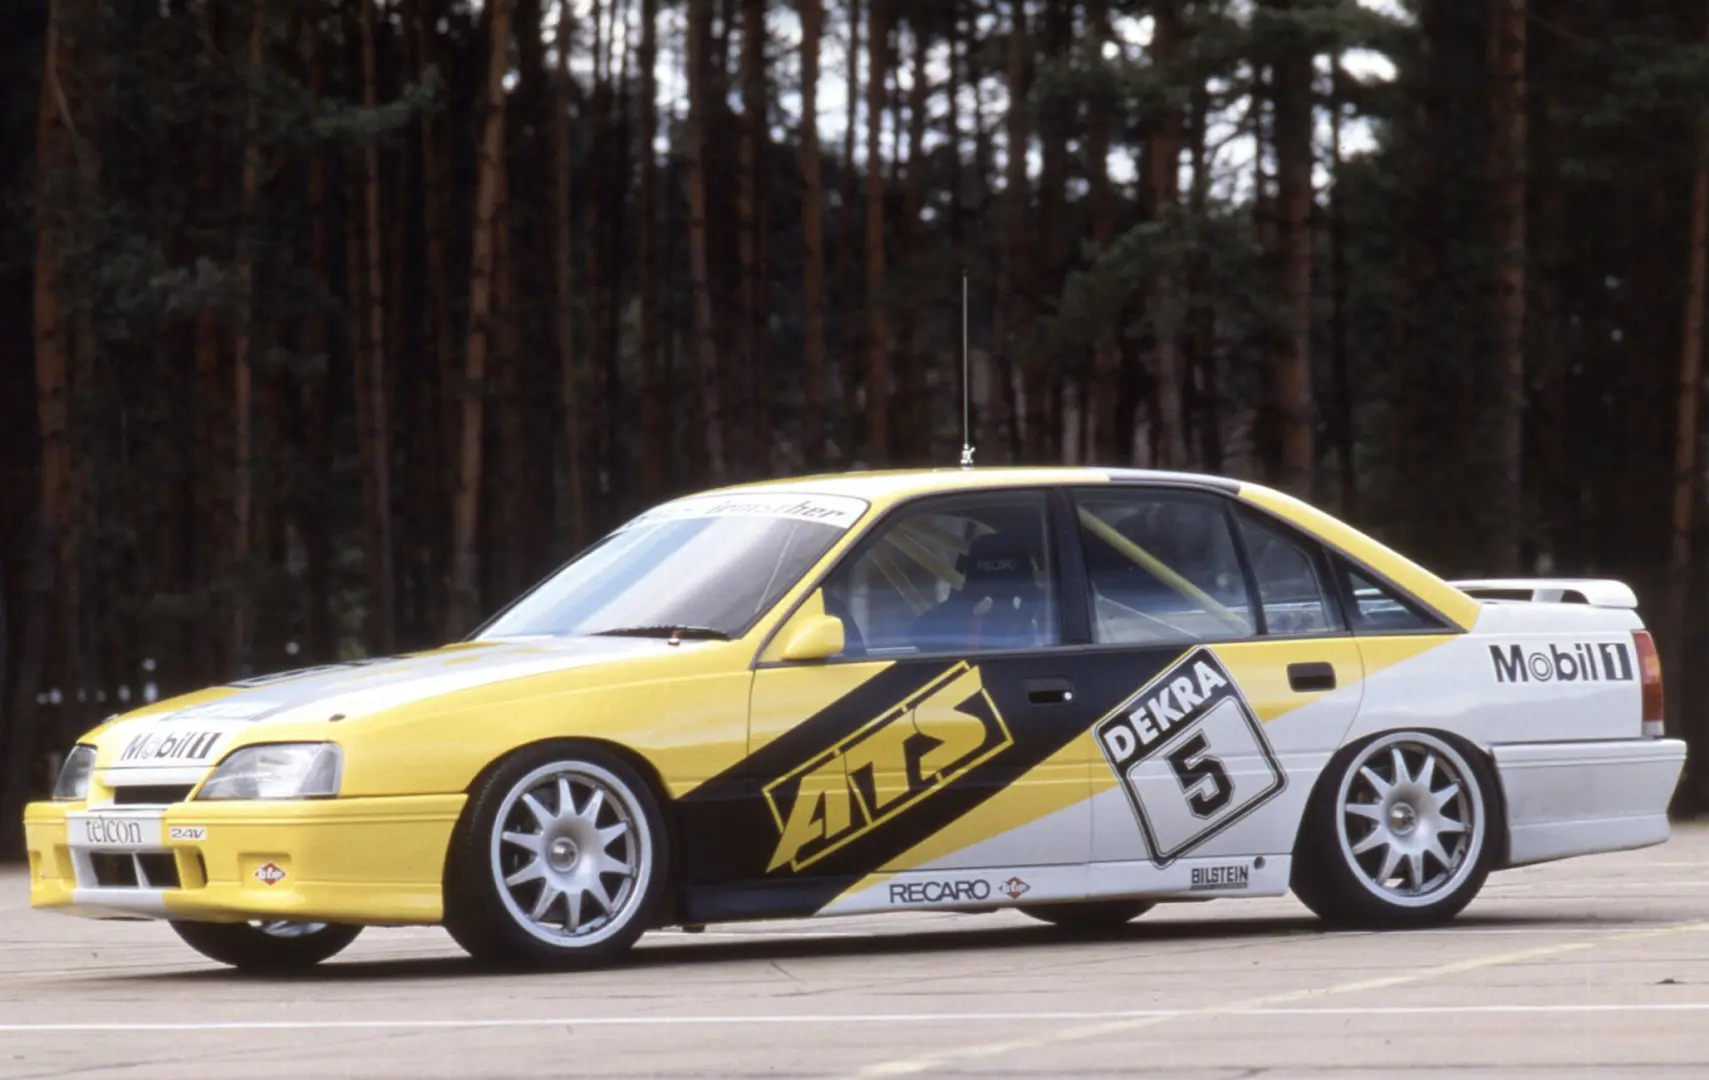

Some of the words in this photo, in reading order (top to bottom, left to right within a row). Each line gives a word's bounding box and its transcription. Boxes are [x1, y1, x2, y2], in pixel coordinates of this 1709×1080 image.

[1104, 660, 1227, 763] DEKRA
[765, 664, 986, 873] ATS
[1164, 728, 1235, 820] 5
[86, 815, 142, 843] telcon
[171, 828, 204, 839] 24V
[1191, 864, 1249, 884] BILSTEIN
[889, 879, 991, 903] RECARO
